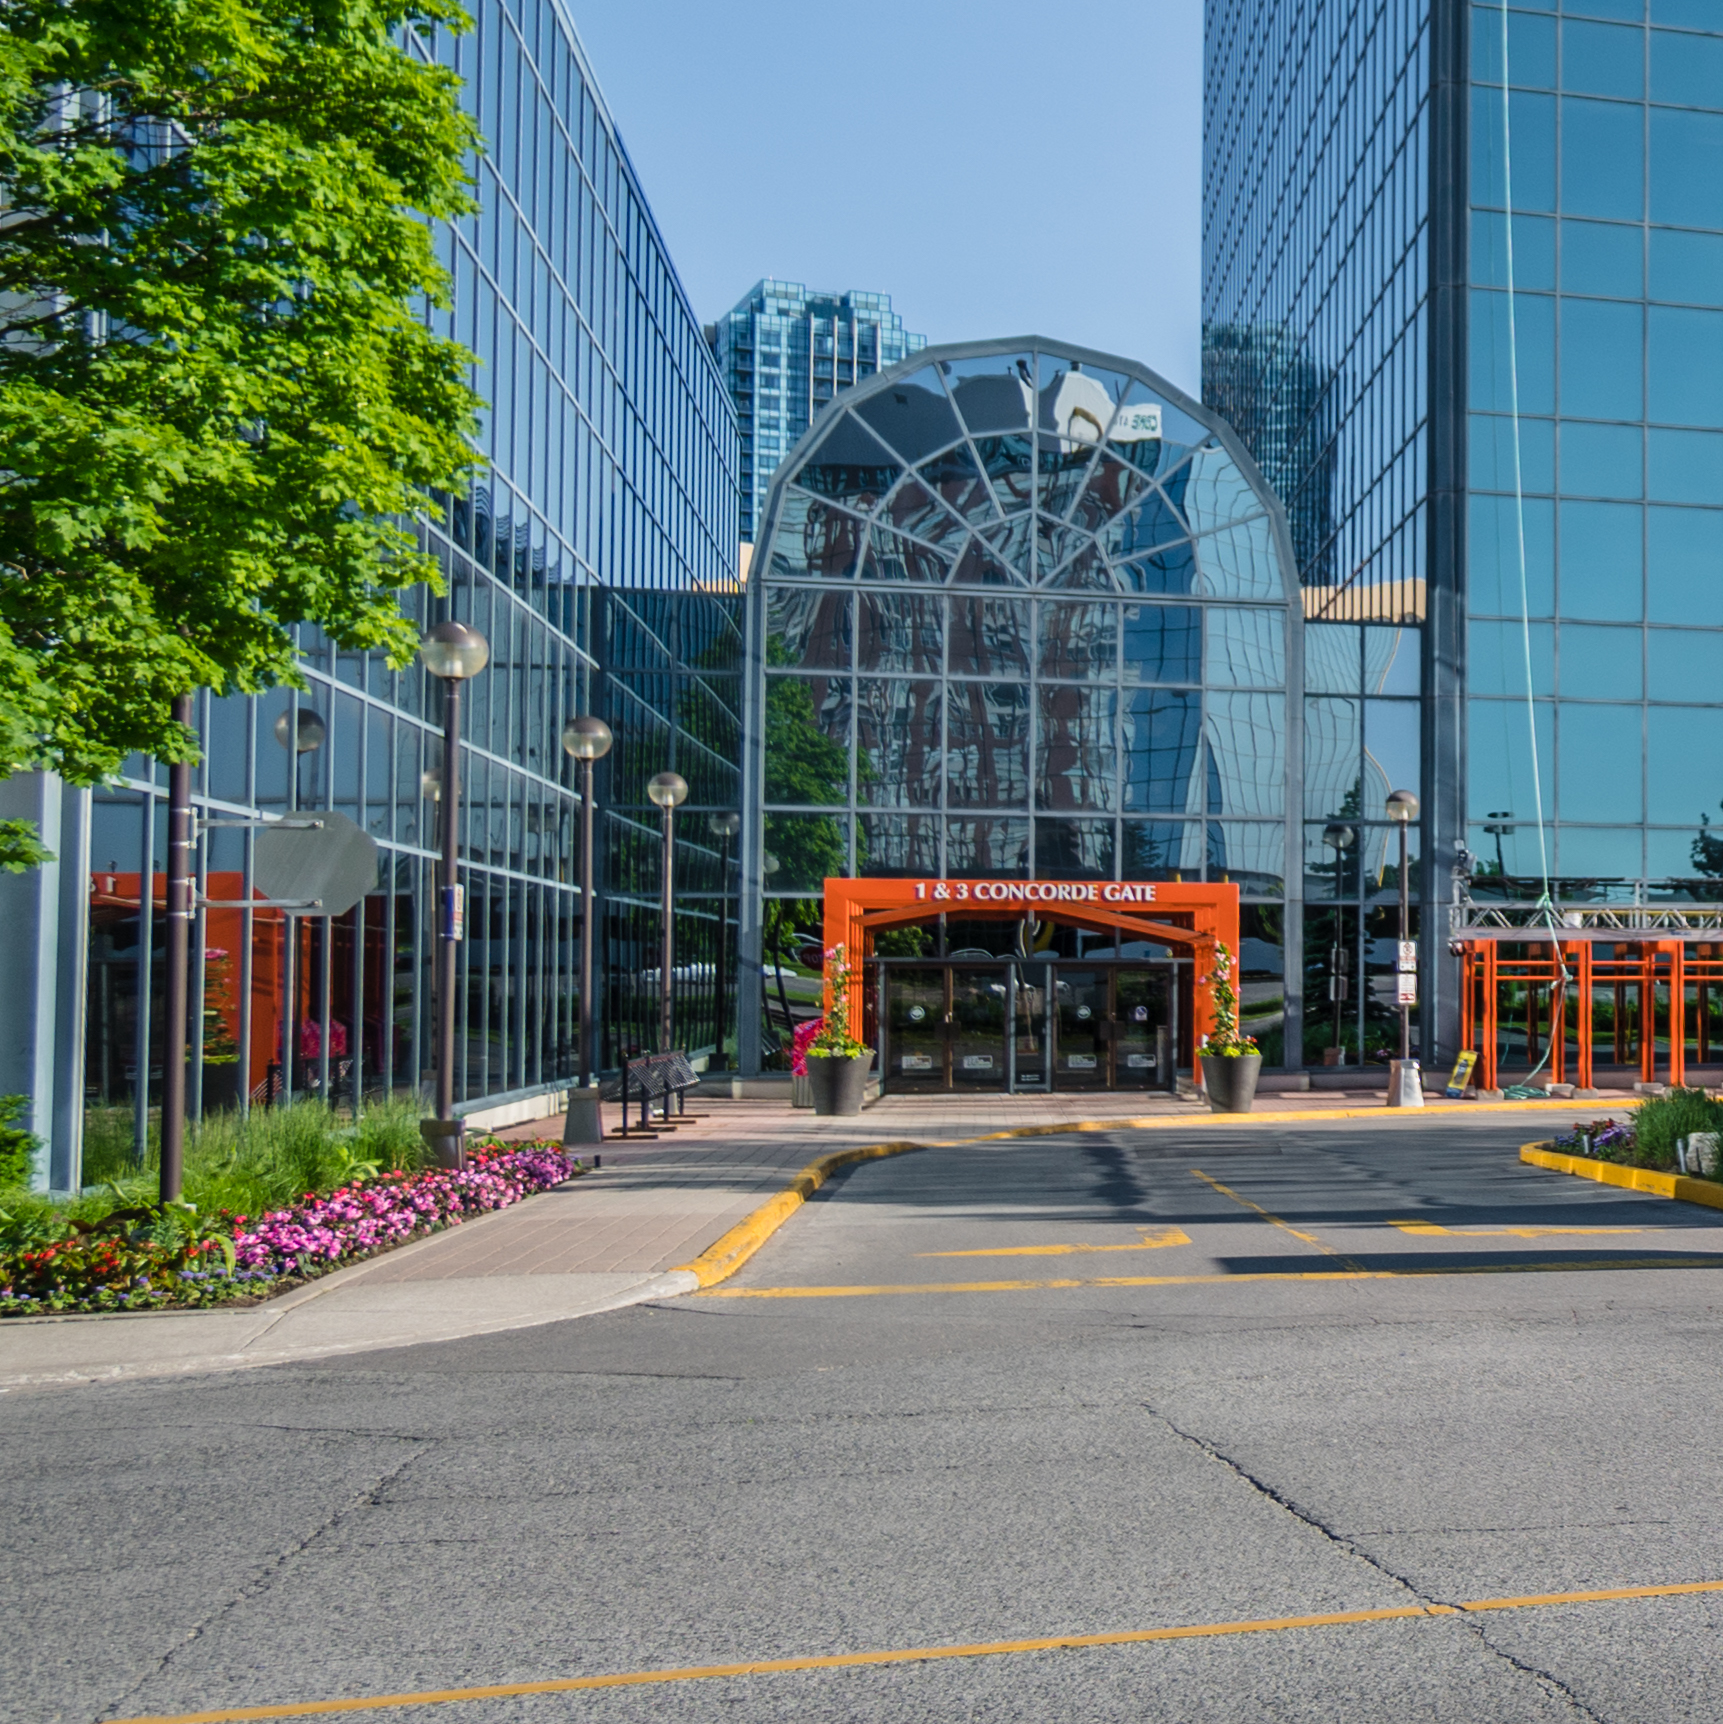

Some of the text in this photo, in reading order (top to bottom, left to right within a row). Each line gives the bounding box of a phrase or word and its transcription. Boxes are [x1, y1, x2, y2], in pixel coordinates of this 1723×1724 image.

[915, 882, 1156, 902] 1 & 3 CONCORDE GATE
